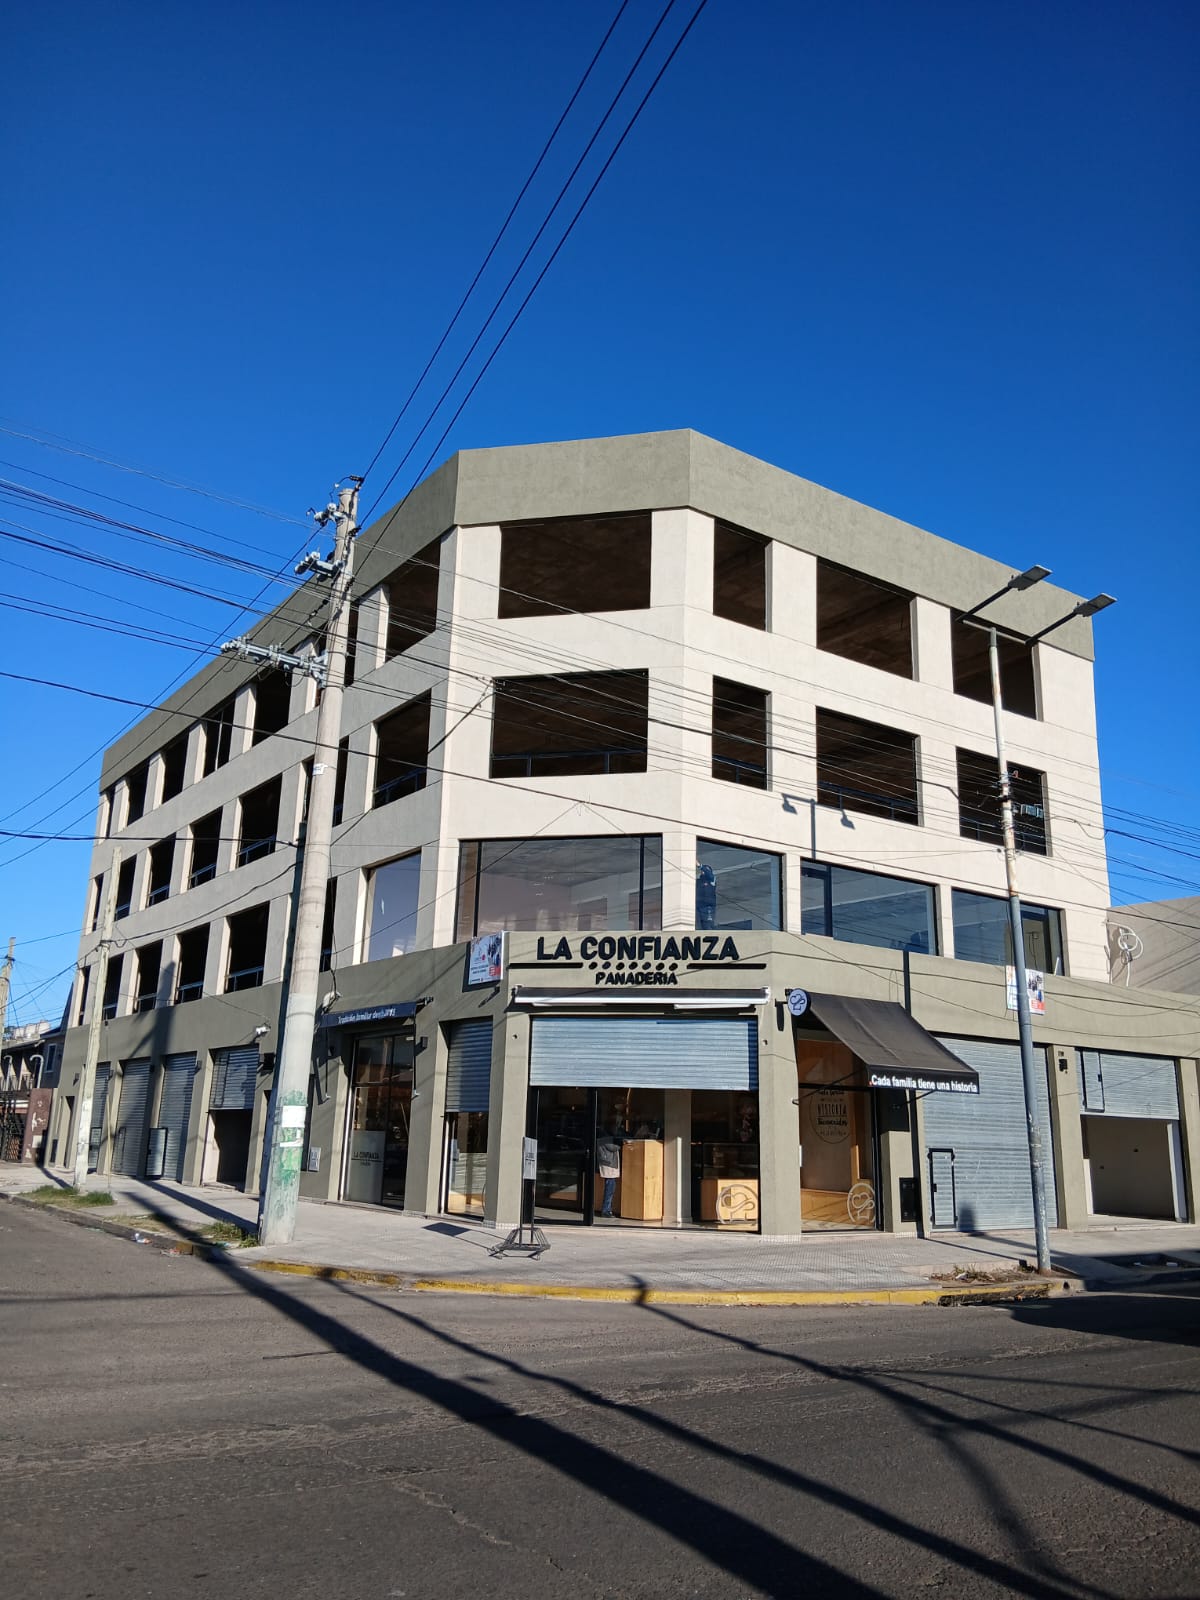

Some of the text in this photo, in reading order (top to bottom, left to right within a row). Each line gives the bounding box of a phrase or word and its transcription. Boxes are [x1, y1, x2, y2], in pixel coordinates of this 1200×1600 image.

[537, 935, 740, 961] LA CONFIANZA
[871, 1074, 978, 1093] Cada familia tiene una historia
